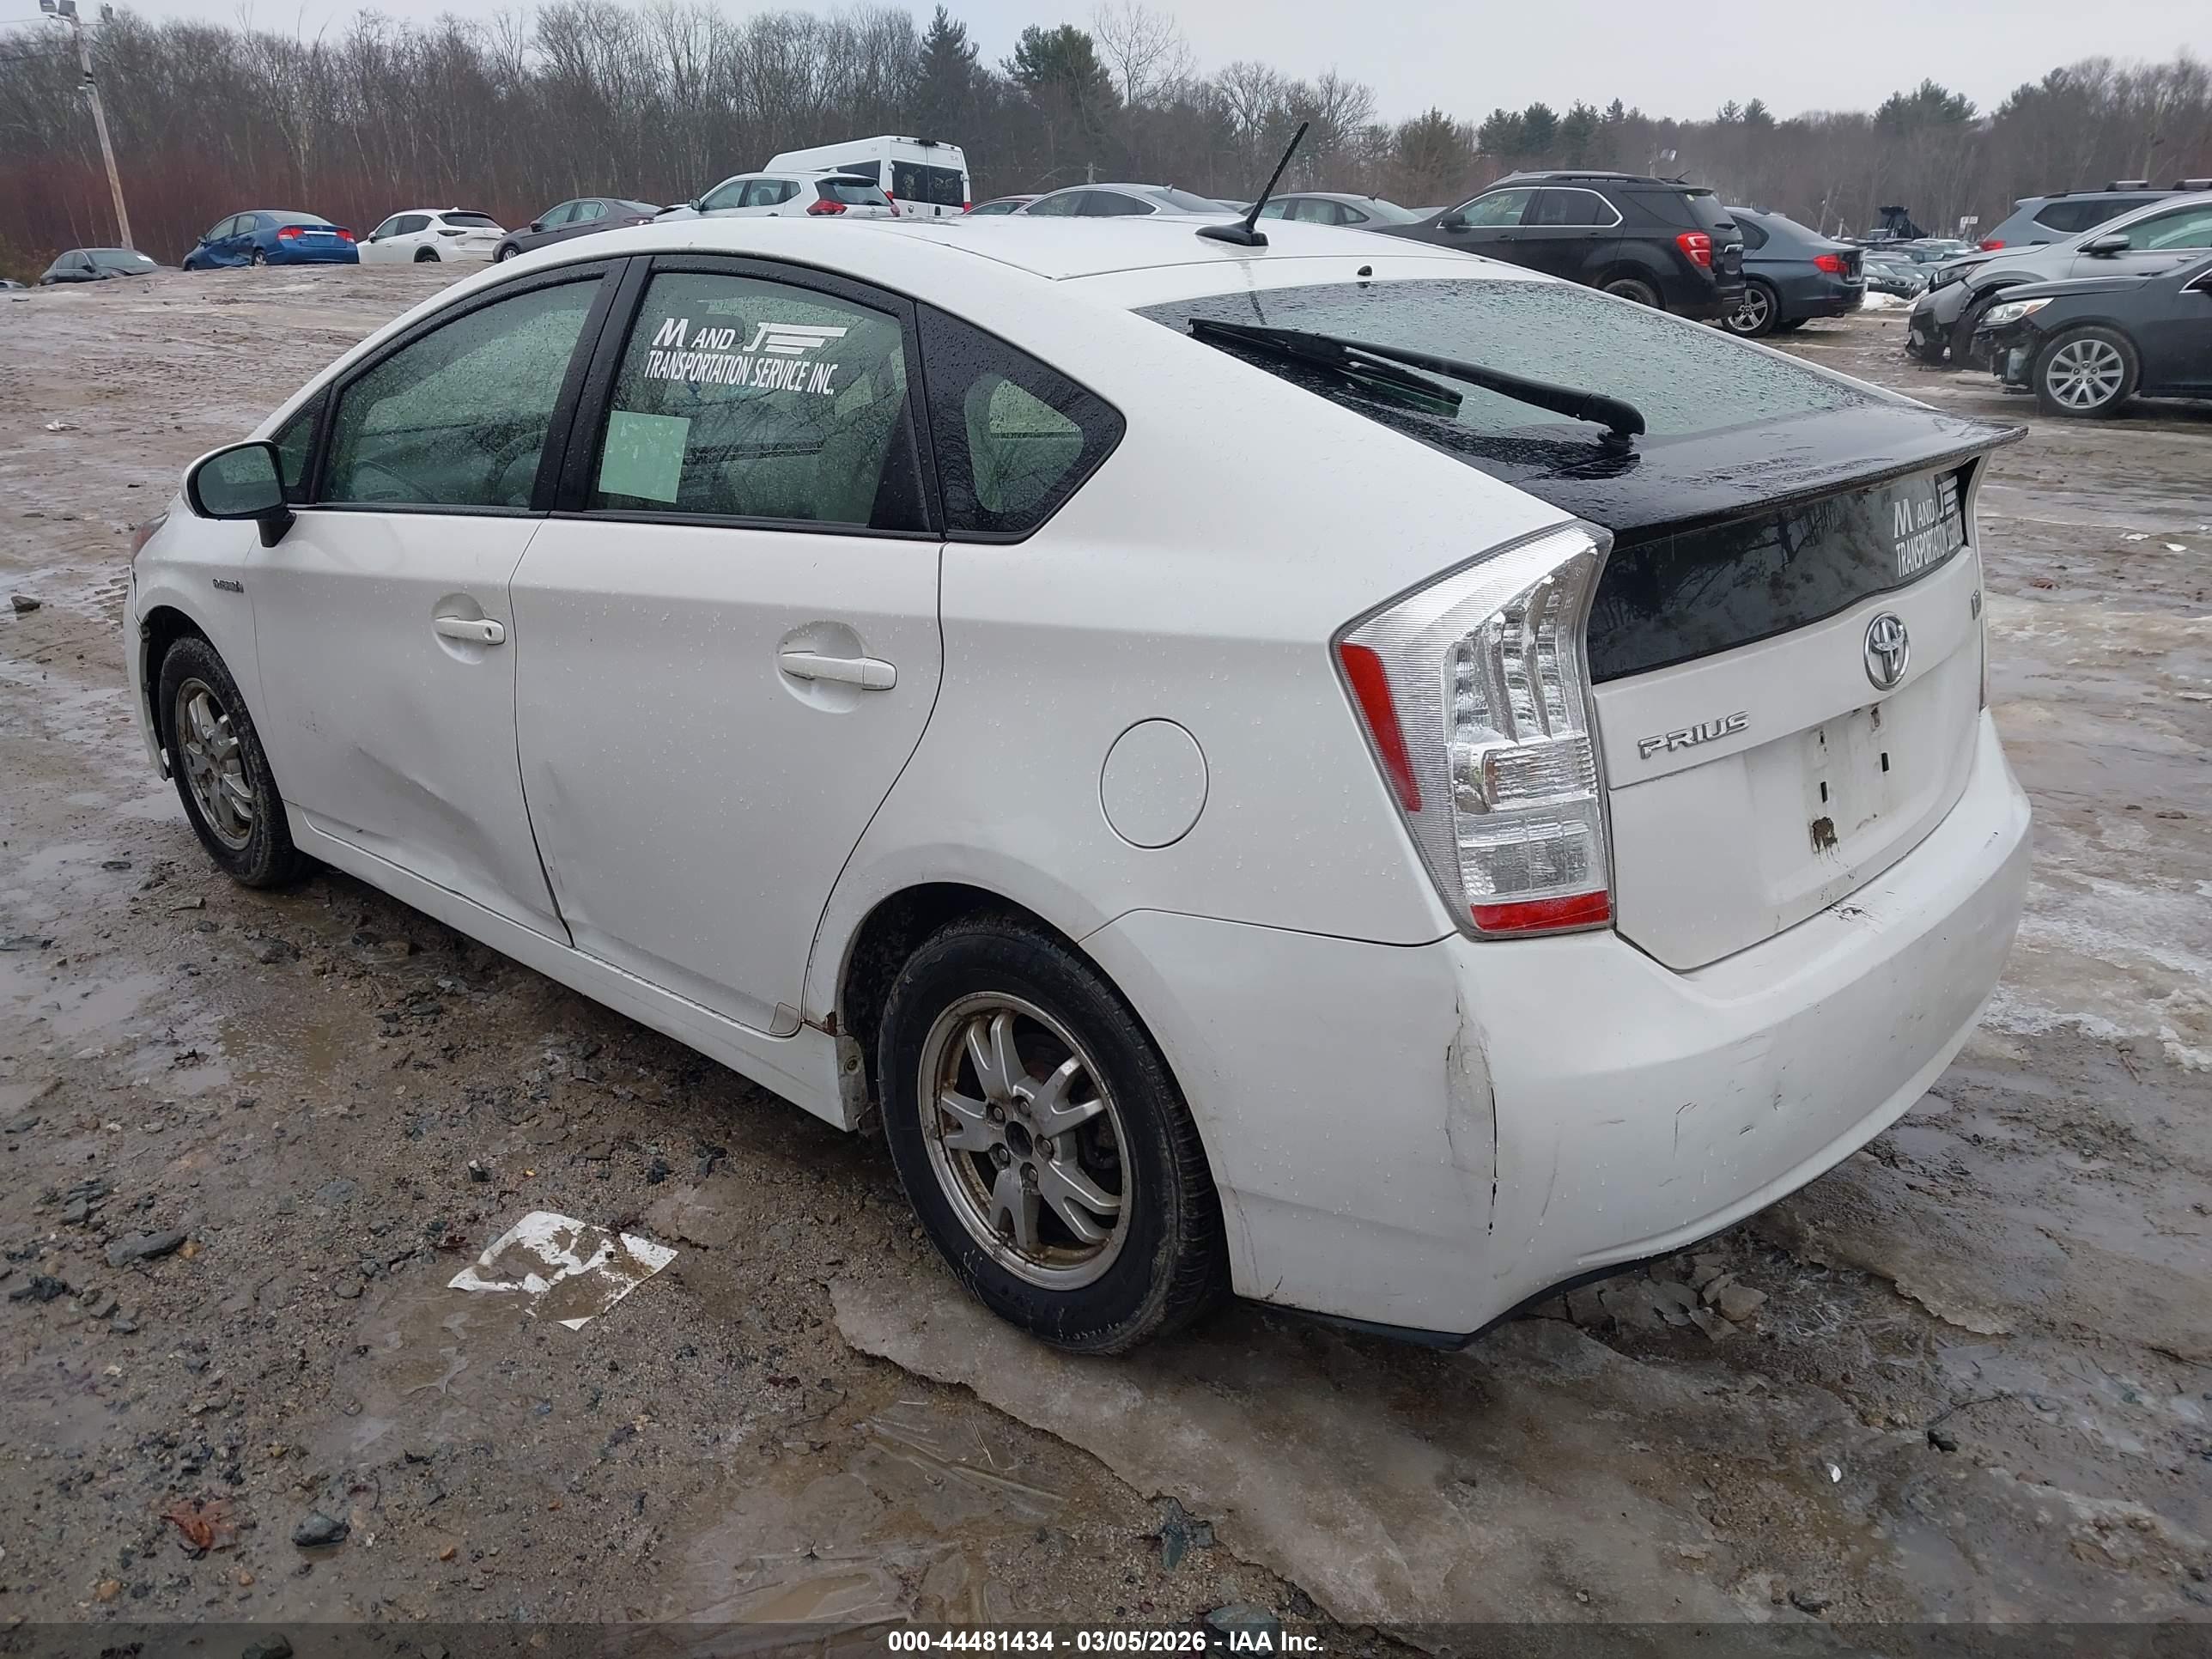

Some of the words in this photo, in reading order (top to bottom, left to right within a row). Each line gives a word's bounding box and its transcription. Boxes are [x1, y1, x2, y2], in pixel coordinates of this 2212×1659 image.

[653, 318, 689, 347] M
[692, 328, 735, 349] AND
[743, 322, 770, 352] J
[646, 351, 754, 386] TRANSPORTATION
[750, 359, 808, 392] SERVICE
[807, 363, 839, 395] INC.
[1894, 498, 1914, 538] M
[1917, 498, 1935, 529] AND
[1937, 483, 1945, 518] J
[1638, 710, 1751, 759] PRIUS
